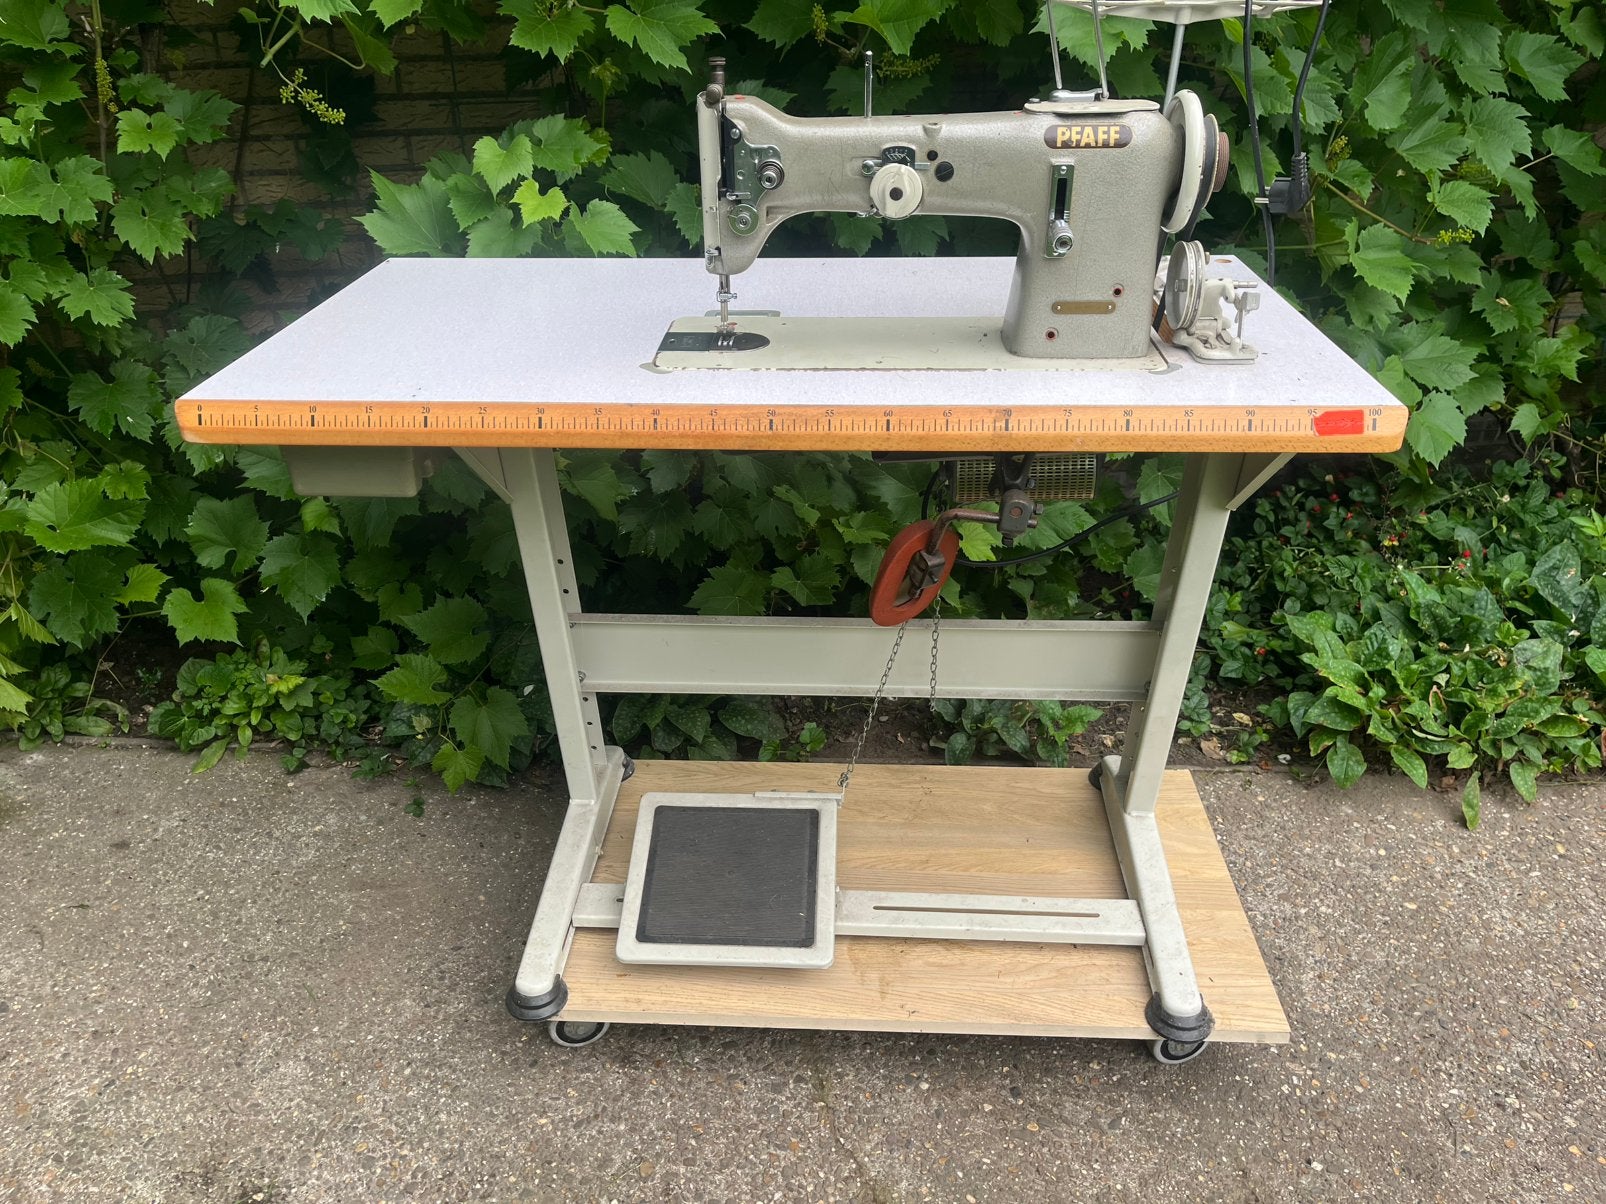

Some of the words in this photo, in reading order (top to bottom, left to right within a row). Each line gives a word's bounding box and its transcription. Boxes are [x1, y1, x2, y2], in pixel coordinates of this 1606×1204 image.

[1056, 126, 1120, 147] PFAFF
[309, 405, 317, 413] 10
[365, 405, 373, 414] 15
[478, 406, 488, 414] 25
[593, 408, 603, 416] 35
[708, 409, 718, 417] 45
[766, 409, 776, 417] 50
[825, 409, 834, 418] 55
[884, 409, 893, 417] 60
[943, 409, 952, 418] 65
[1002, 409, 1012, 417] 70
[1063, 409, 1072, 417] 75
[1123, 409, 1133, 417] 80
[1184, 409, 1194, 417] 85
[1368, 408, 1382, 416] 100
